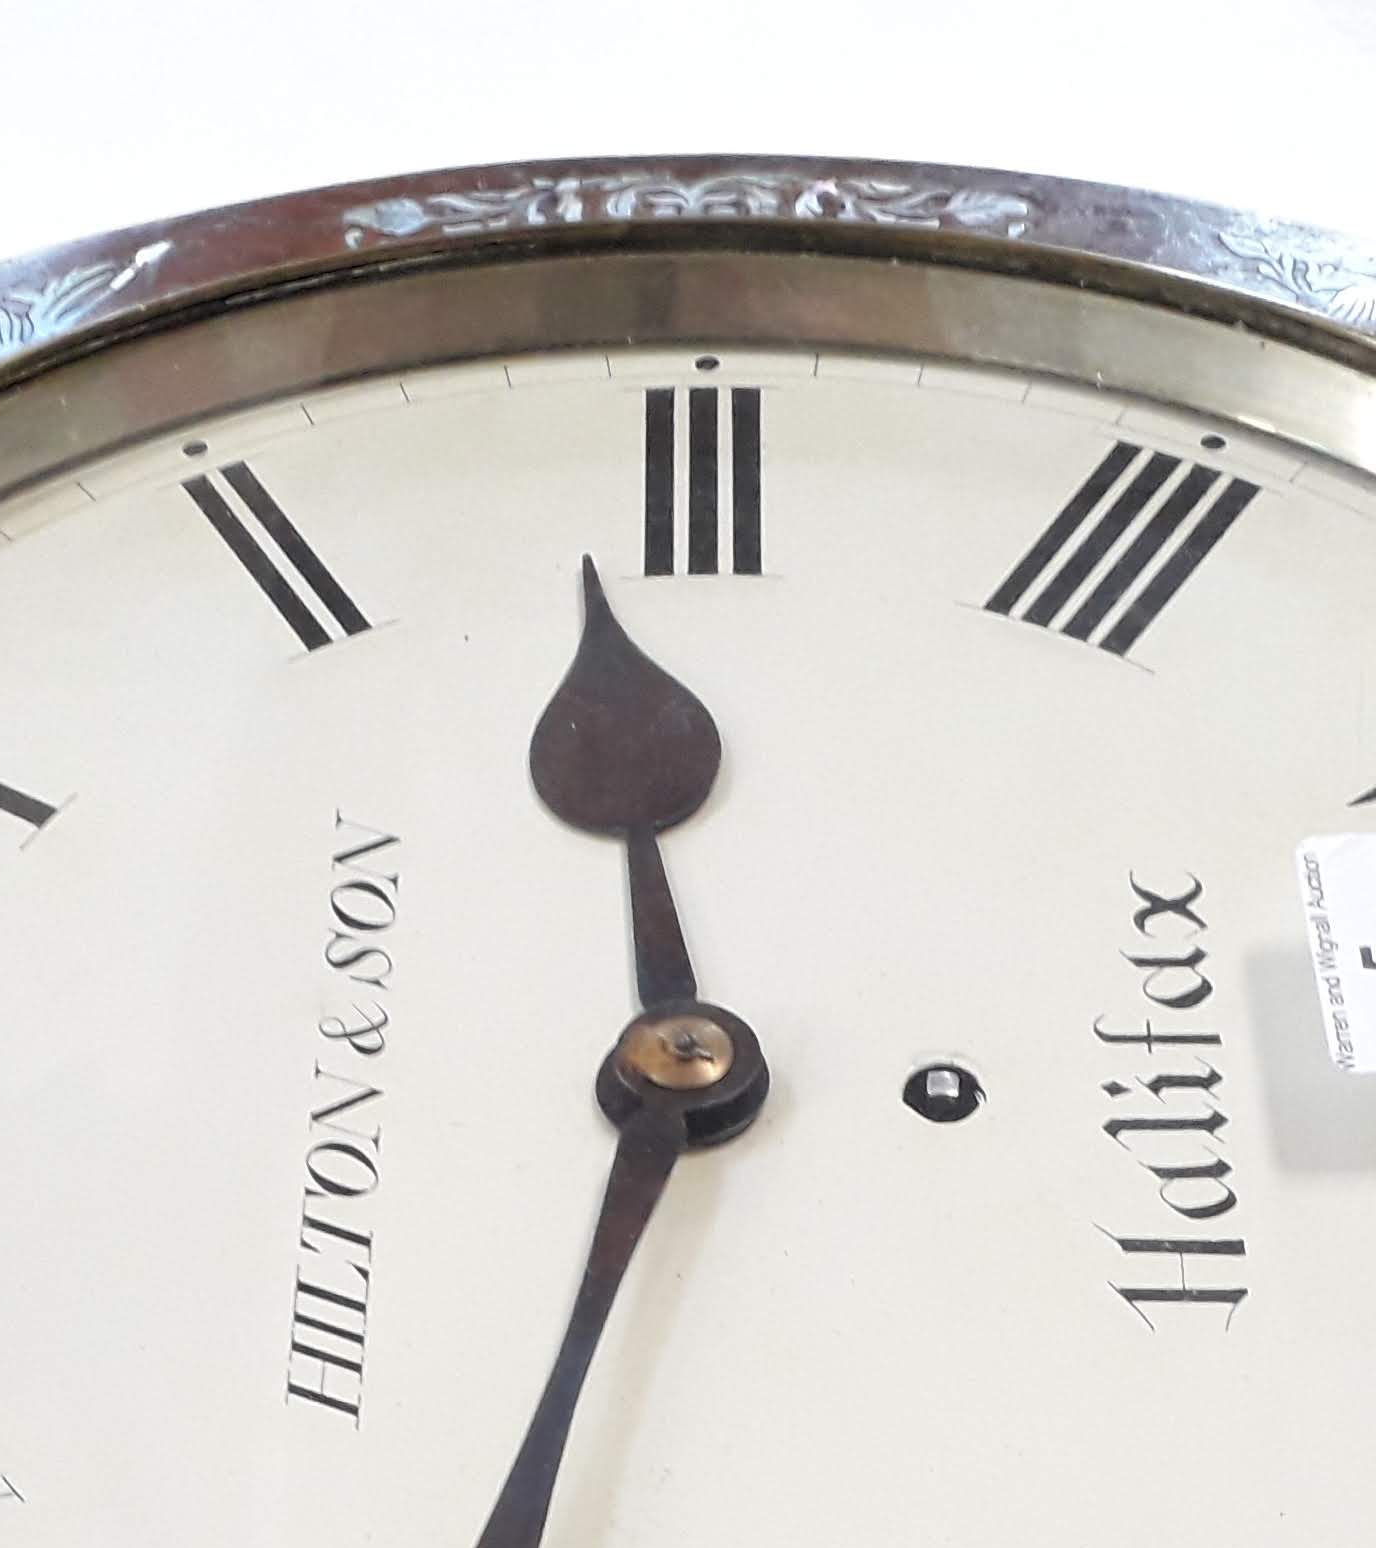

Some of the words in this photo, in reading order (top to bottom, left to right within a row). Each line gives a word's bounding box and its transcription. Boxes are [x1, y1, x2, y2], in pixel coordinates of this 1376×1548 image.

[177, 455, 401, 664] II
[633, 385, 782, 579] III
[955, 437, 1269, 674] IIII
[324, 807, 401, 990] SON
[1303, 851, 1328, 910] Auction
[1309, 911, 1339, 973] Wignall
[318, 1000, 389, 1055] &
[1320, 974, 1345, 1006] and
[1330, 1009, 1356, 1072] Warren
[1092, 869, 1249, 1333] Halifax
[286, 1058, 383, 1430] HILTON
